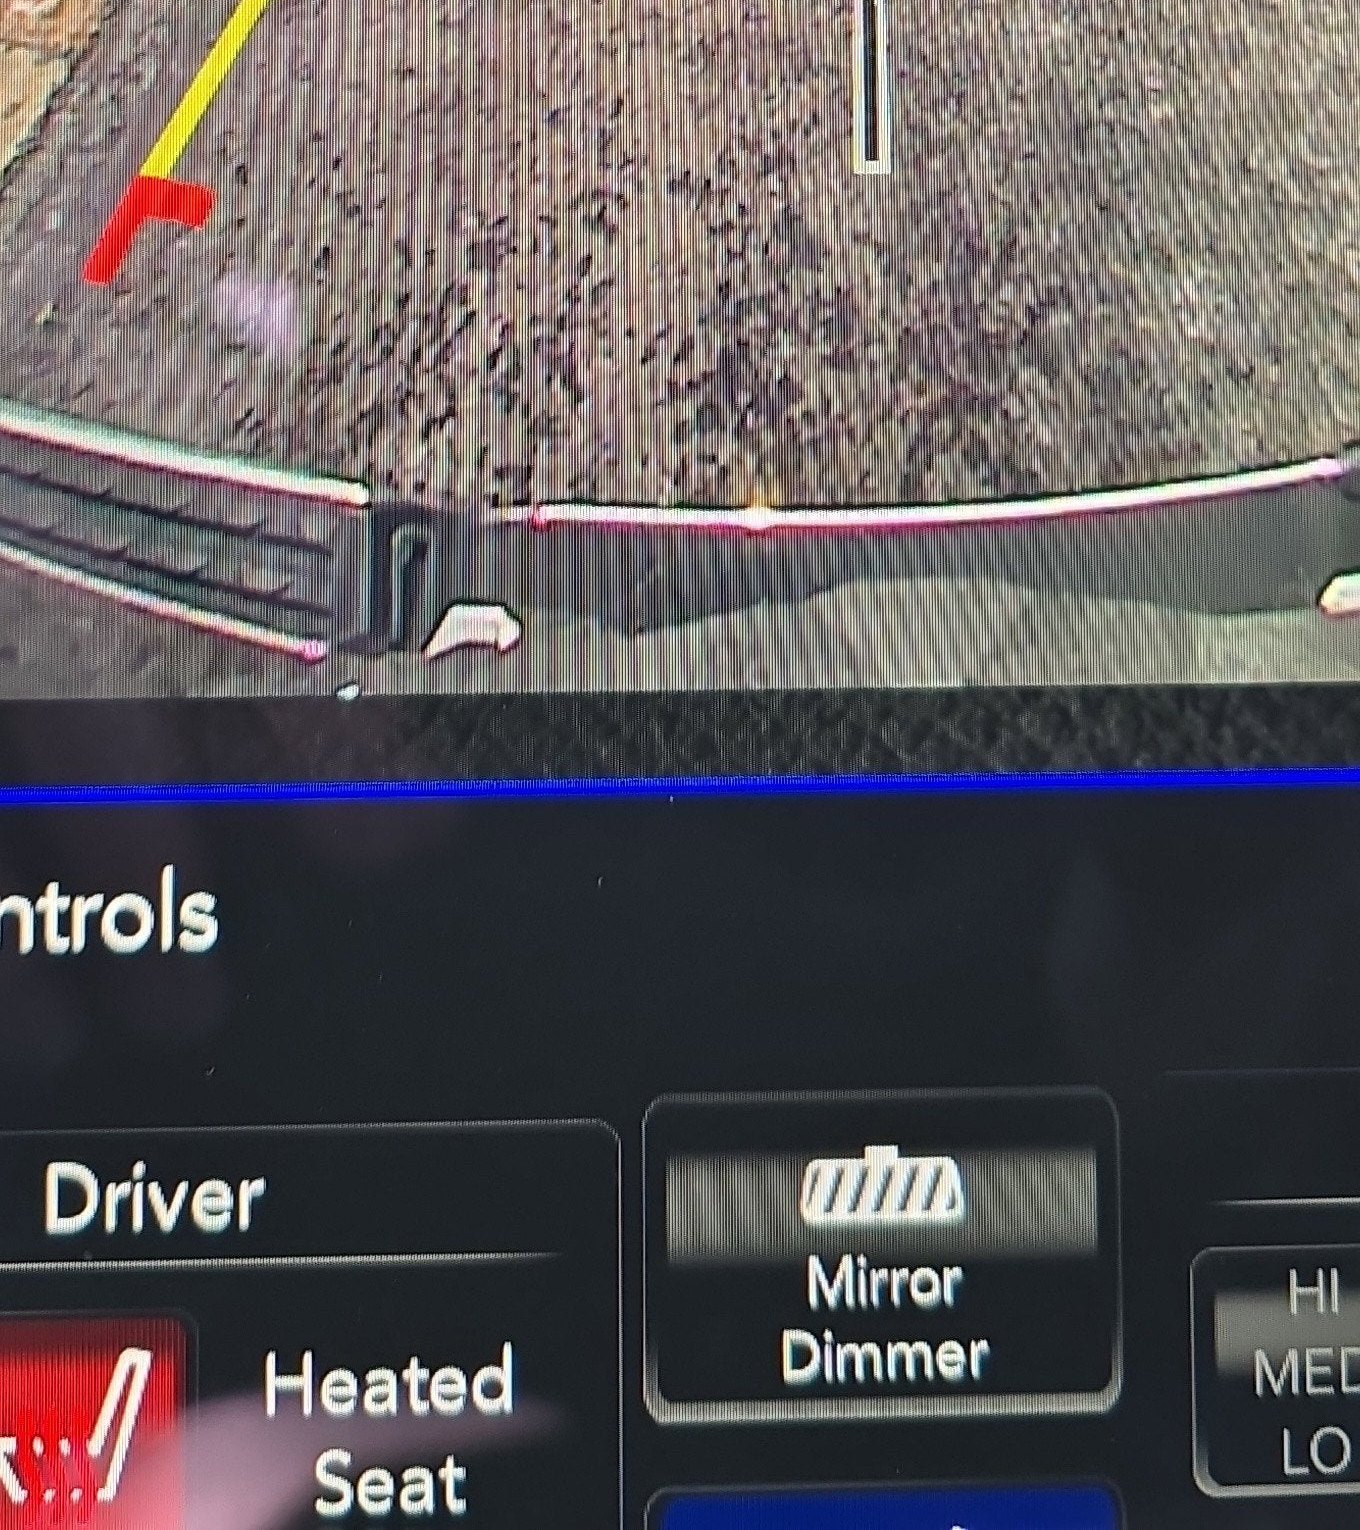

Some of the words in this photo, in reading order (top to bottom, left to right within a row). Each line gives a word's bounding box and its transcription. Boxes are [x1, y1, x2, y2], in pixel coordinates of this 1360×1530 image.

[46, 1160, 267, 1235] Driver
[807, 1253, 963, 1309] Mirror
[1289, 1268, 1340, 1317] HI
[266, 1341, 514, 1419] Heated
[782, 1329, 990, 1384] Dimmer
[1283, 1426, 1352, 1476] LO
[315, 1448, 468, 1517] Seat
